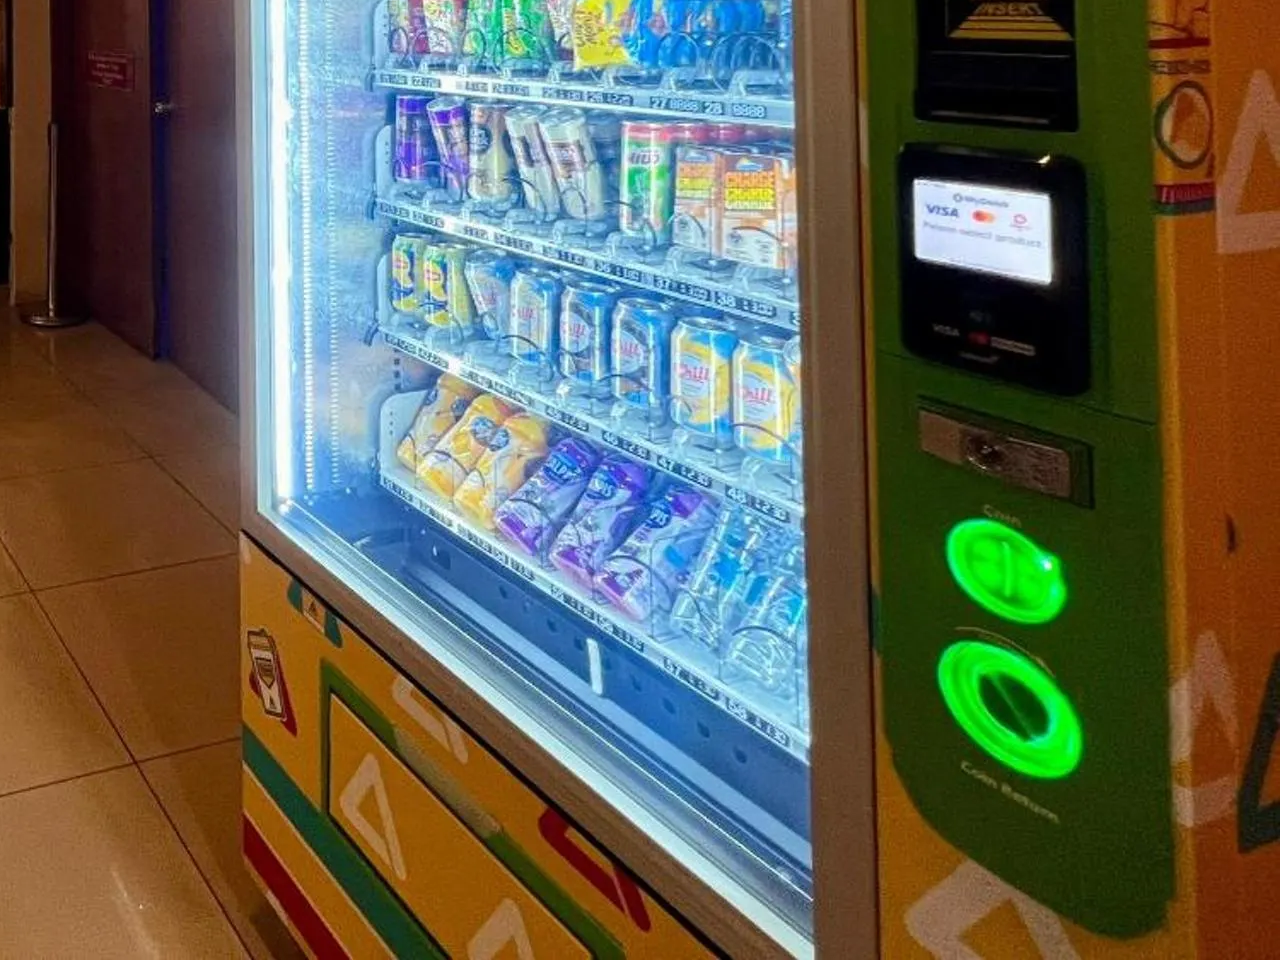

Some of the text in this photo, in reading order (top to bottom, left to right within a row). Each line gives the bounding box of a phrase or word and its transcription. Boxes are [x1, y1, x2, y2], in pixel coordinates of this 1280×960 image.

[926, 204, 959, 218] VISA
[933, 324, 960, 336] VISA
[982, 504, 1022, 528] Coin
[960, 760, 1060, 824] Coin Return
